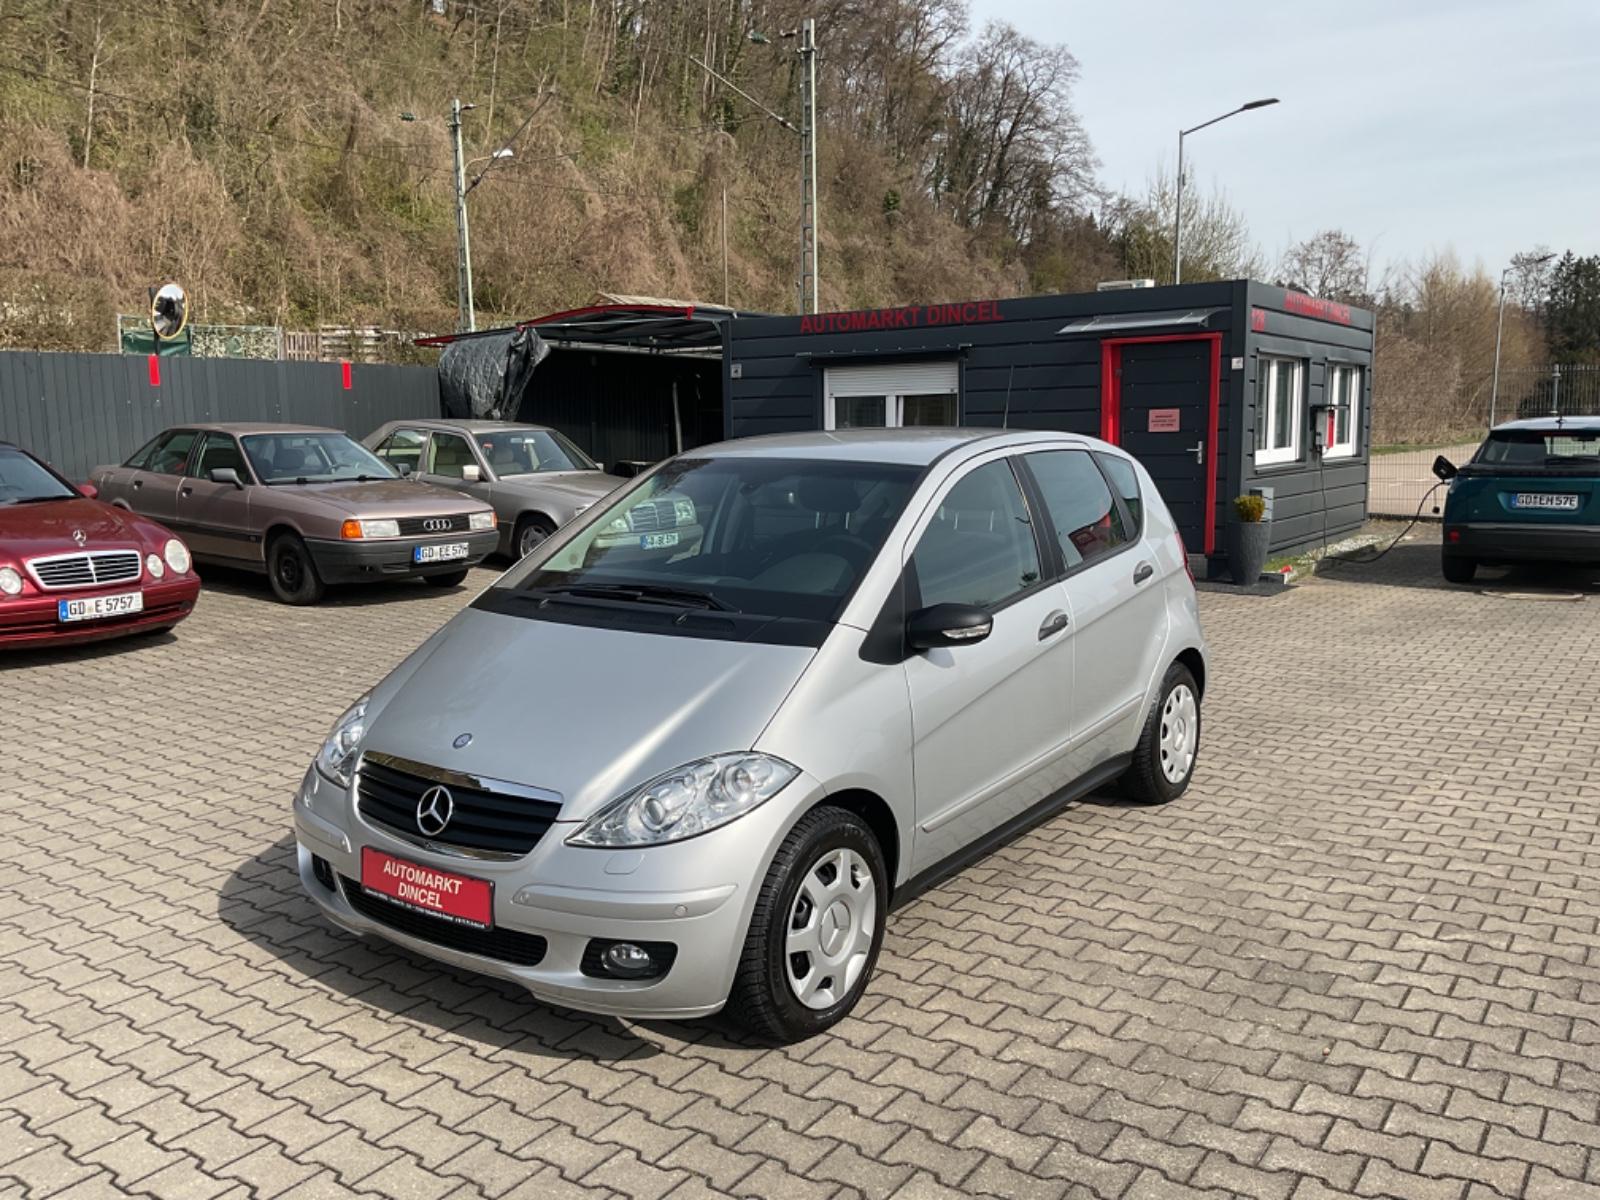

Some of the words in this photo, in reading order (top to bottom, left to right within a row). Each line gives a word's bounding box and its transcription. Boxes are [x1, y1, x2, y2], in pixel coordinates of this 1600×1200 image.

[801, 306, 921, 334] AUTOMARKT
[927, 300, 1004, 325] DINCEL
[69, 601, 85, 615] GD
[95, 600, 102, 613] E
[106, 596, 133, 612] 5757
[383, 860, 462, 895] AUTOMARKT
[398, 882, 443, 908] DINCEL
